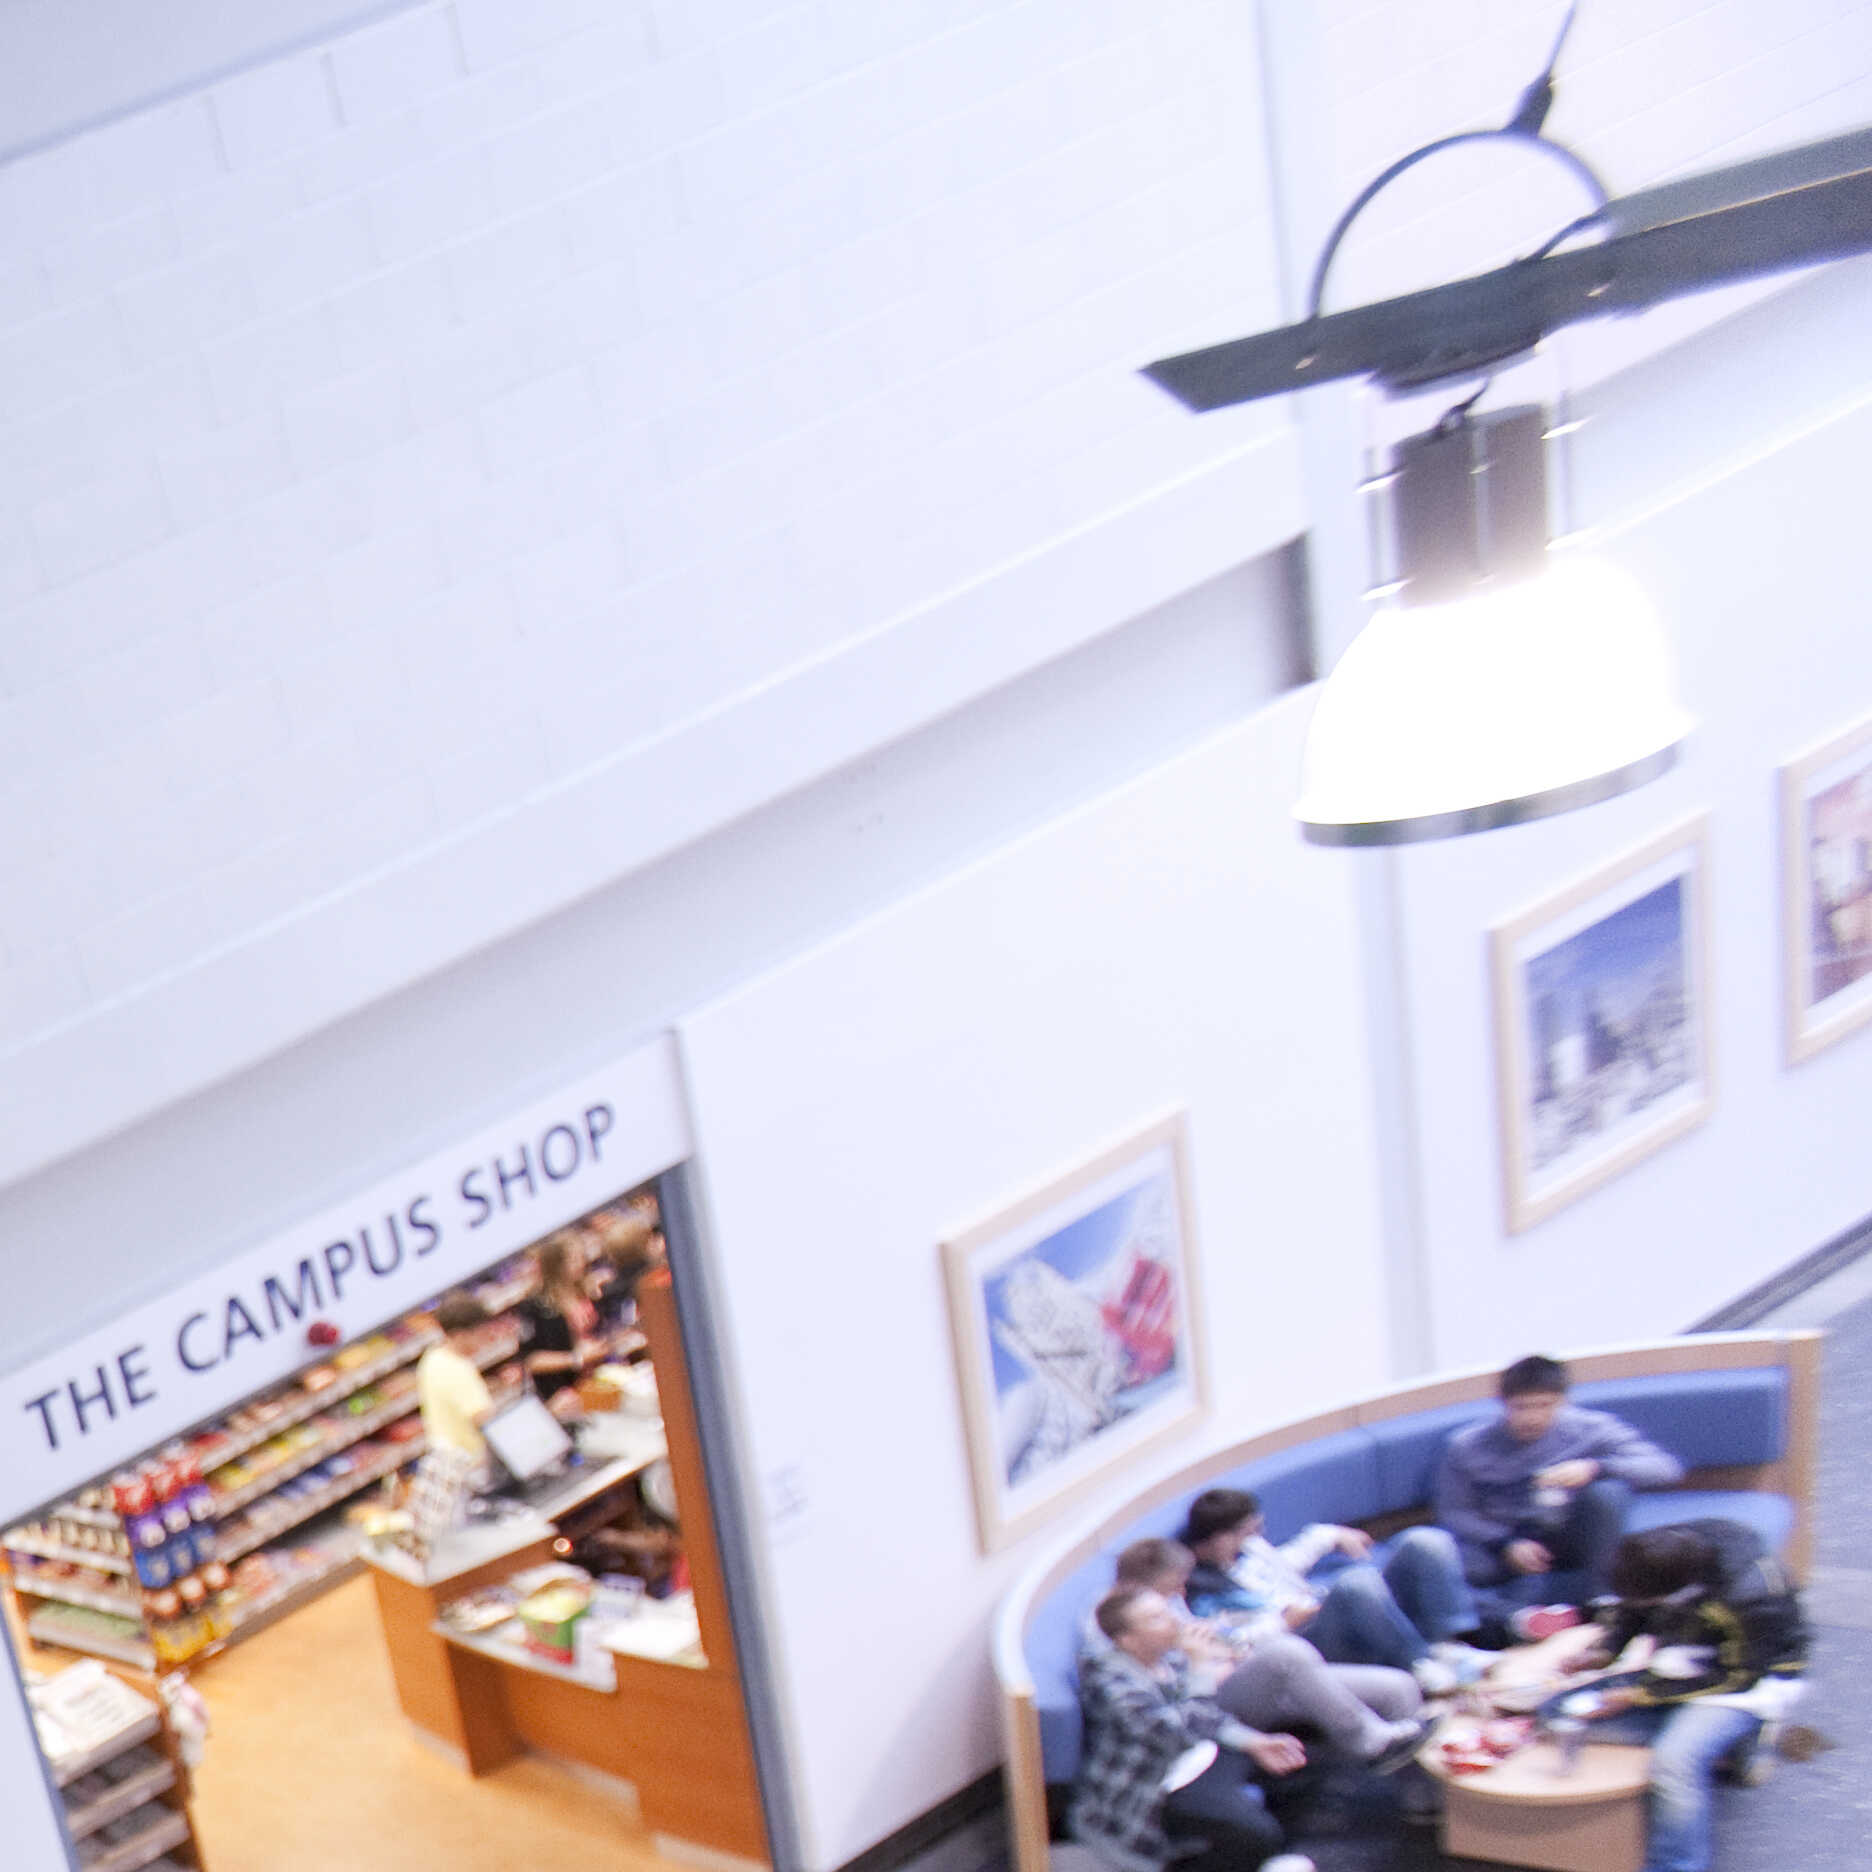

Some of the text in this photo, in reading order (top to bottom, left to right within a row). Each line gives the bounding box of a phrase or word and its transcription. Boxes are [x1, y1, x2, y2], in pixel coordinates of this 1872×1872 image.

[24, 1102, 615, 1451] THE CAMPUS SHOP
